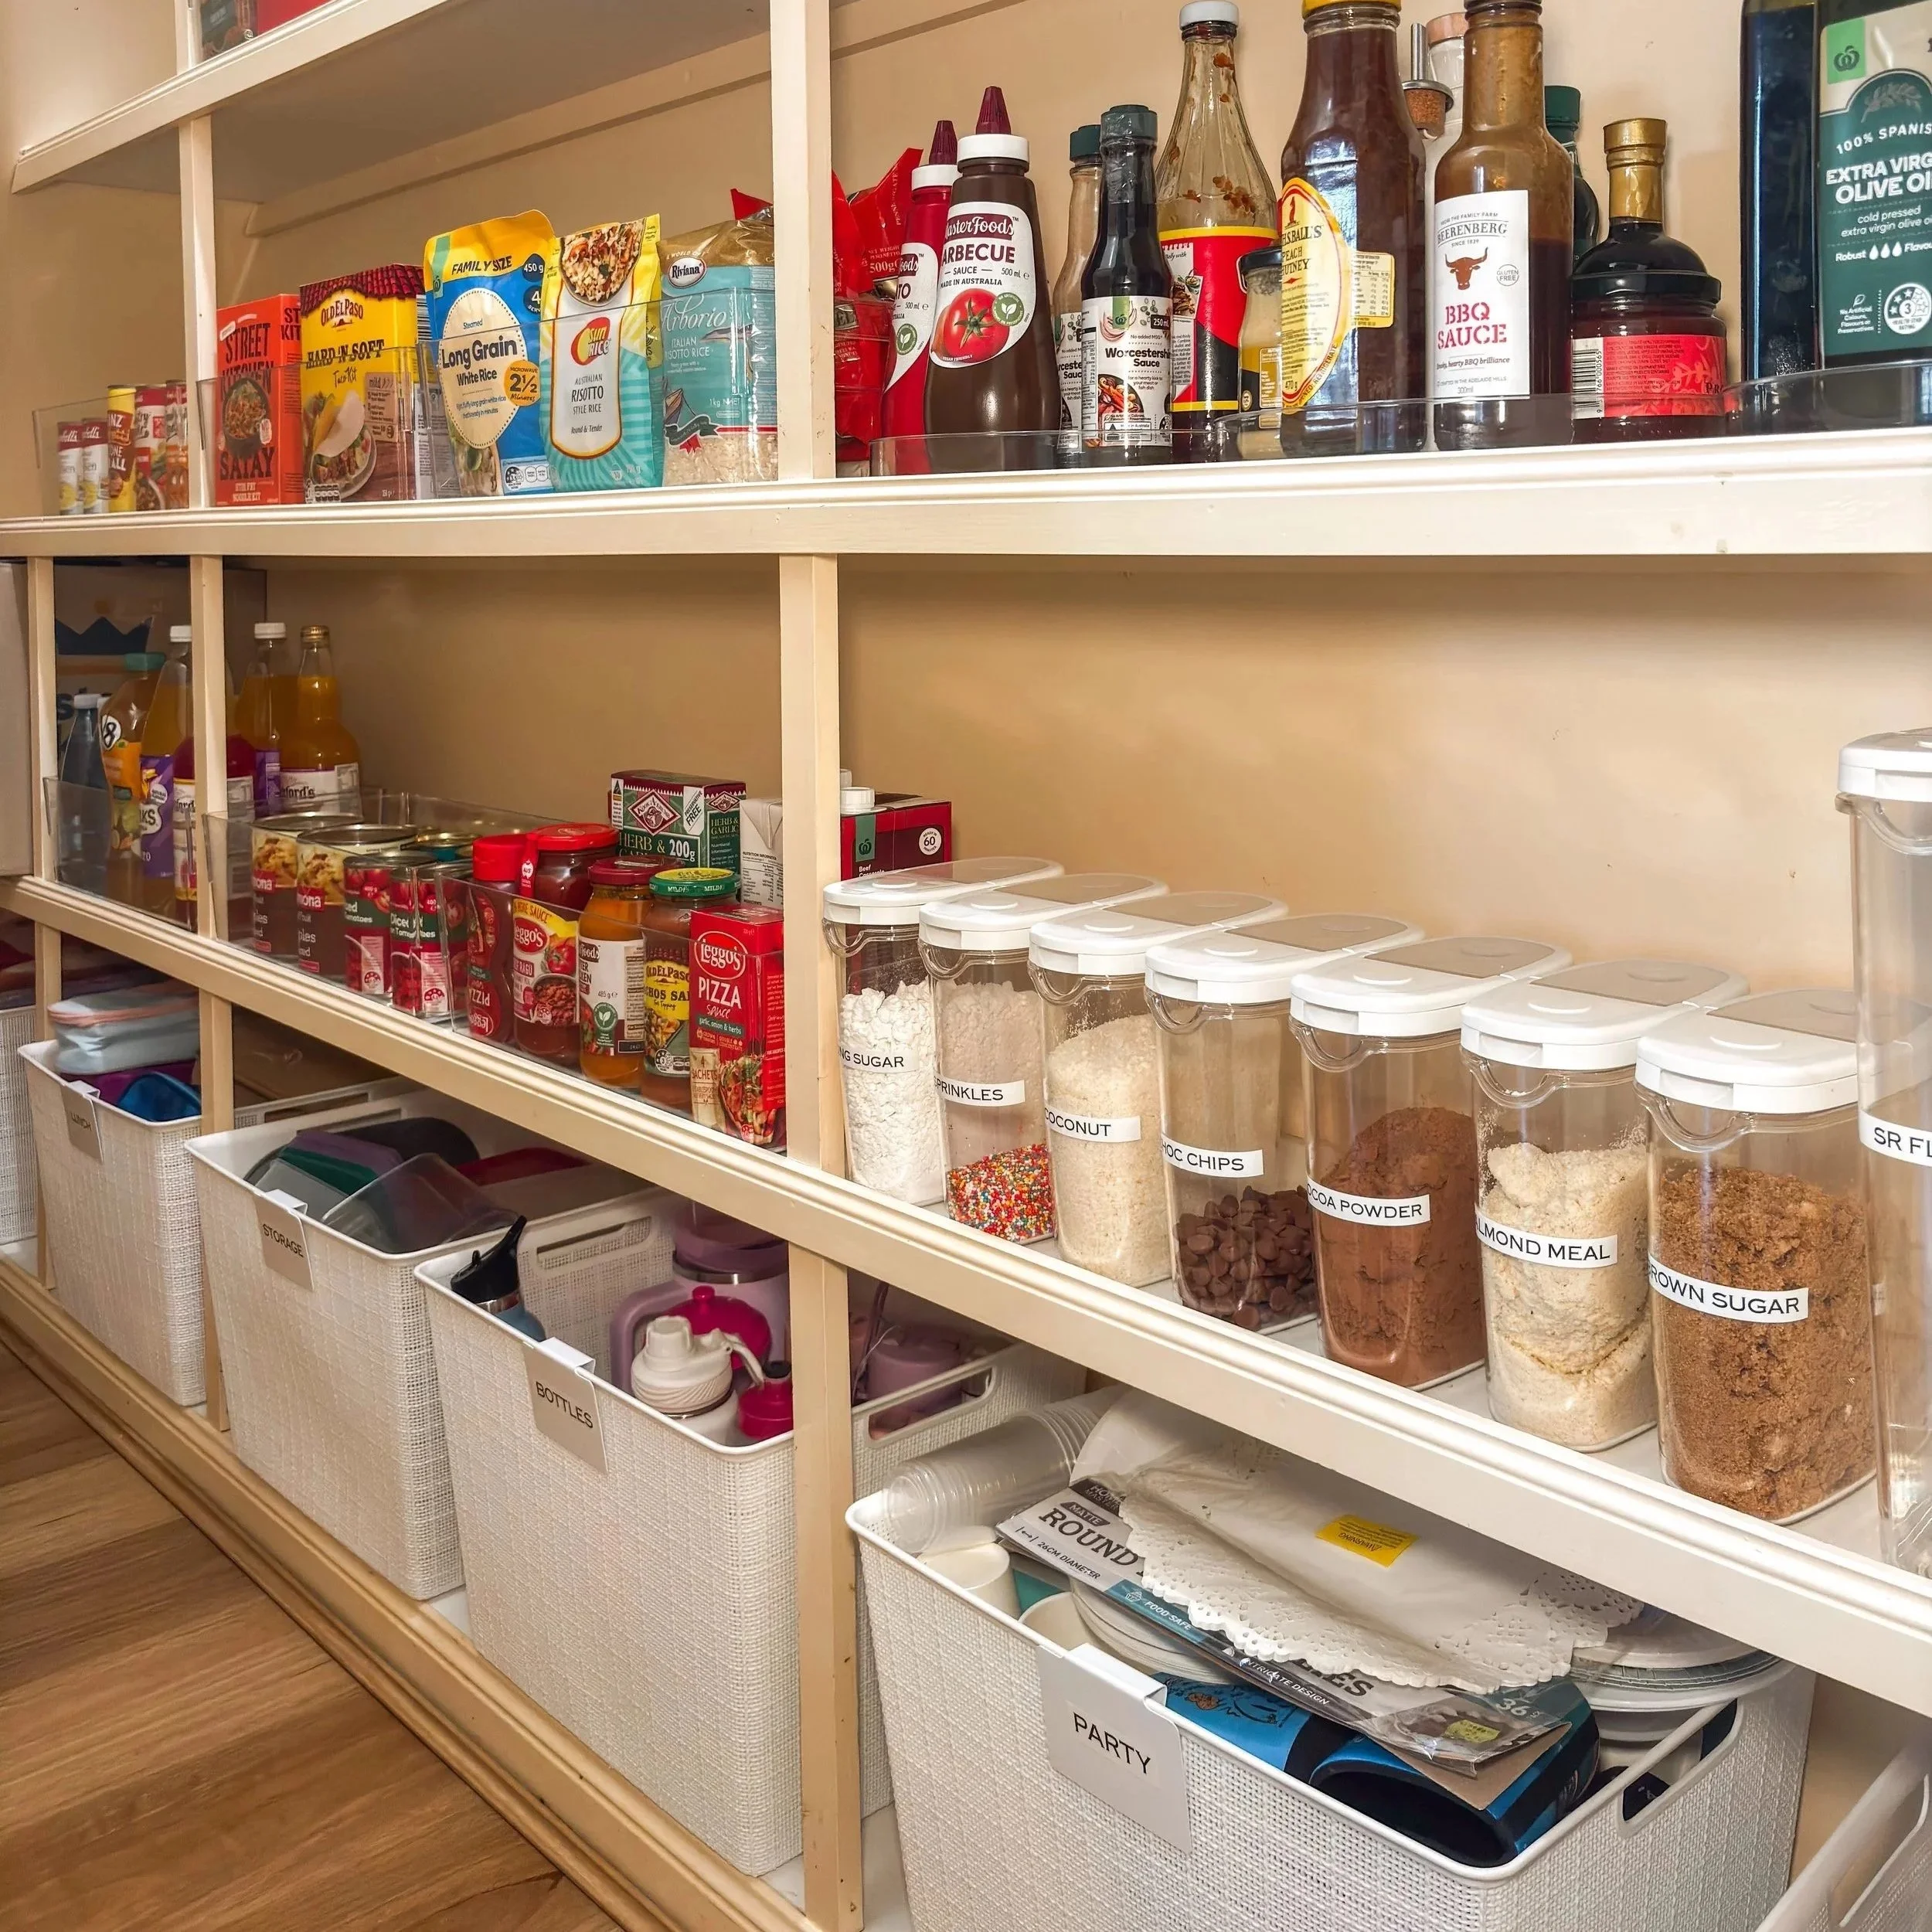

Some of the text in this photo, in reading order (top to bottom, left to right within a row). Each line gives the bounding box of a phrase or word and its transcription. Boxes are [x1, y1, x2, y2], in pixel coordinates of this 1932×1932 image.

[1836, 132, 1874, 155] 100%
[1826, 160, 1888, 185] EXTRA
[1835, 175, 1903, 204] OLIVE
[1857, 205, 1921, 223] cold pressed
[1841, 218, 1922, 237] extra virgin olive
[451, 255, 512, 275] FAMILY SIZE
[1835, 250, 1866, 261] Robust
[524, 263, 537, 272] 450
[953, 267, 978, 275] SAUCE
[1002, 267, 1013, 277] 500
[961, 277, 1002, 286] AUSTRALIA
[1154, 318, 1163, 327] 250
[1445, 301, 1490, 325] BBQ
[464, 318, 483, 329] Steamed
[226, 323, 270, 364] STREET
[672, 336, 696, 347] ITALIAN
[1437, 324, 1507, 349] SAUCE
[349, 339, 385, 362] SOFT
[441, 335, 518, 370] Long Grain
[692, 347, 710, 356] RICE
[1134, 359, 1159, 367] Sauce
[457, 369, 498, 386] White Rice
[575, 373, 603, 386] AUSTRALIAN
[571, 386, 604, 403] RISOTTO
[589, 403, 601, 413] RICE
[685, 804, 702, 826] FREE
[711, 818, 732, 828] HERB
[619, 832, 652, 851] HERB
[657, 840, 665, 853] &
[669, 838, 696, 862] 200g
[923, 836, 936, 846] 60
[859, 864, 872, 872] Beef
[701, 939, 743, 970] Leggo's
[699, 977, 742, 1009] PIZZA
[707, 1005, 731, 1019] sauce
[711, 1021, 723, 1029] onion
[729, 1025, 742, 1034] herbs
[853, 1053, 904, 1068] SUGAR
[1044, 1107, 1111, 1137] COCONUT
[1874, 1127, 1903, 1151] SR
[1161, 1141, 1244, 1171] HOC CHIPS
[1340, 1201, 1423, 1219] POWDER
[263, 1223, 304, 1258] STORAGE
[1548, 1244, 1611, 1261] MEAL
[1712, 1292, 1800, 1315] SUGAR
[536, 1381, 594, 1429] BOTTLES
[1039, 1508, 1139, 1566] ROUND
[1038, 1541, 1101, 1580] 26CM DIAMETER
[1145, 1600, 1192, 1631] FOOD SAFE
[1246, 1659, 1330, 1706] NTRICATE DESIGN
[1073, 1711, 1151, 1775] PARTY
